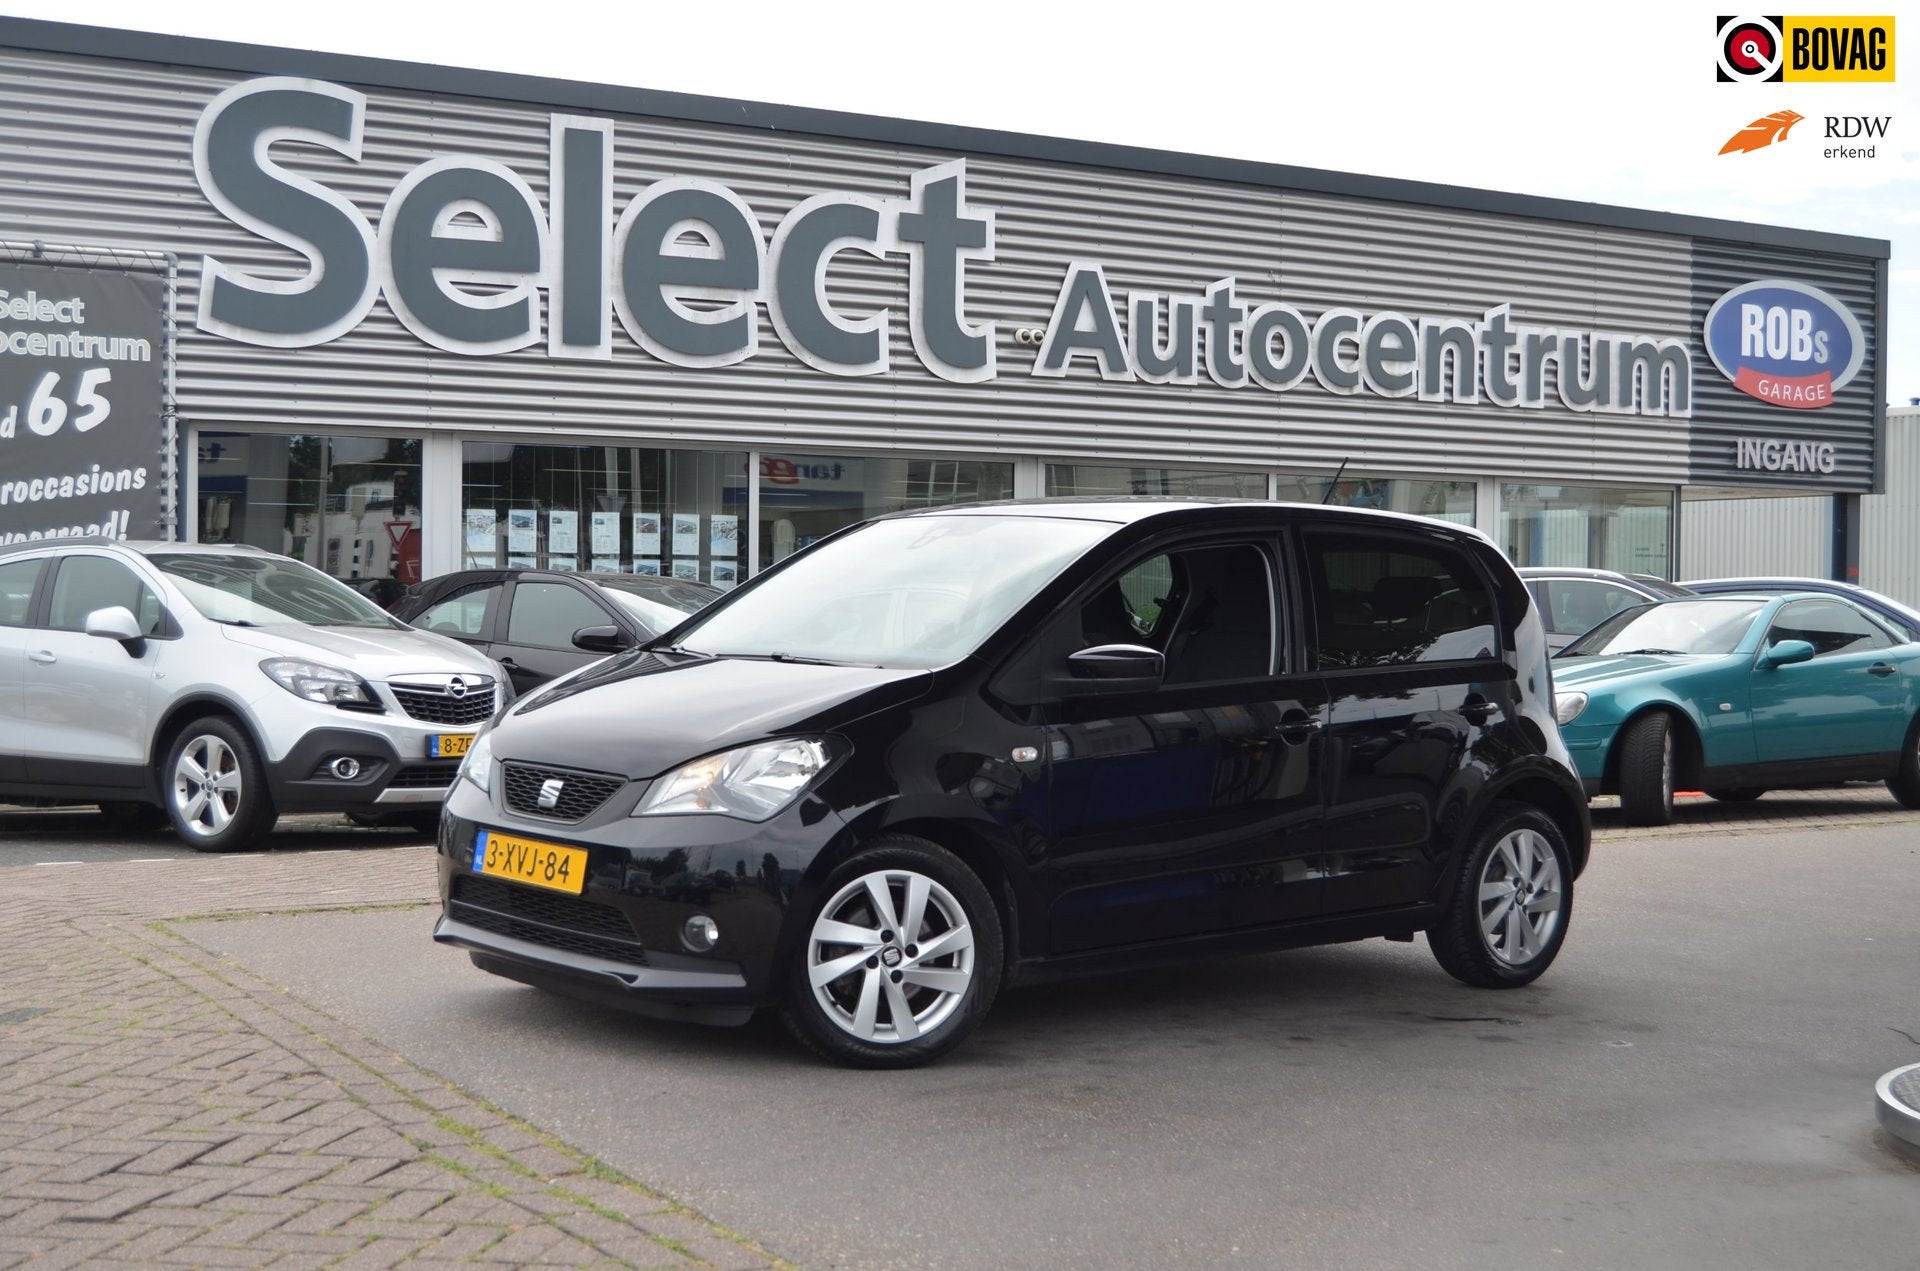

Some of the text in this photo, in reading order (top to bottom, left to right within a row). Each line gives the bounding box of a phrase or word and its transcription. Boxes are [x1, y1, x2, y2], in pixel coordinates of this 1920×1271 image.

[193, 76, 1692, 418] Select Autocentrum
[1741, 303, 1829, 364] ROBs
[28, 367, 112, 436] 65
[1758, 379, 1826, 401] GARAGE
[1736, 437, 1835, 474] INGANG
[475, 839, 570, 884] NL 3-XVJ-84
